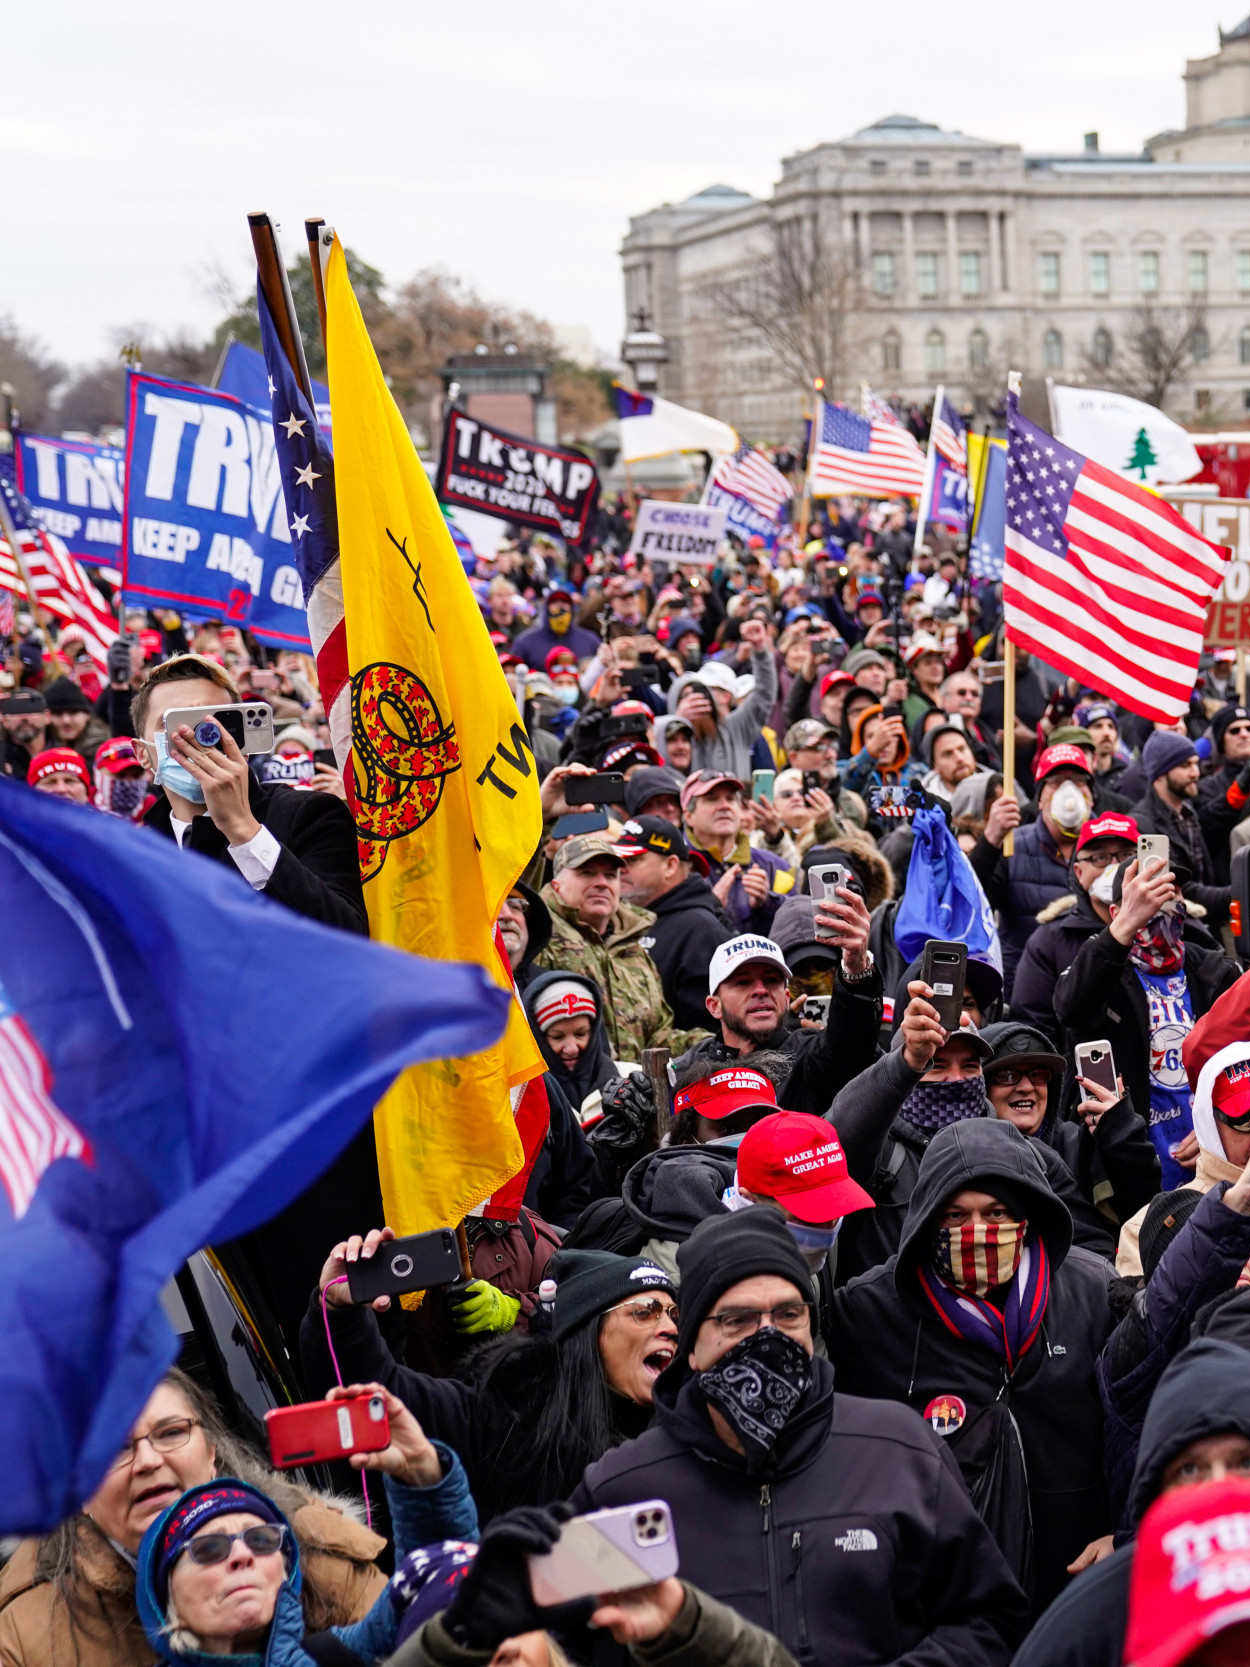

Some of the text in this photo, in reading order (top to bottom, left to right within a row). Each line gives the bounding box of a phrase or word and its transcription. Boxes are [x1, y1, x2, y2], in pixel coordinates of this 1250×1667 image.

[447, 474, 486, 501] FUCK
[488, 486, 532, 512] YOUR
[650, 508, 711, 528] CHOOSE
[132, 517, 200, 563] KEEP
[641, 531, 719, 556] FREEDOM
[723, 939, 777, 957] TRUMP
[709, 1072, 734, 1086] KEEP
[784, 1150, 814, 1166] MAKE
[792, 1158, 825, 1175] GREAT
[834, 1536, 863, 1547] NORTH
[846, 1529, 863, 1538] THE
[843, 1543, 863, 1552] FACE
